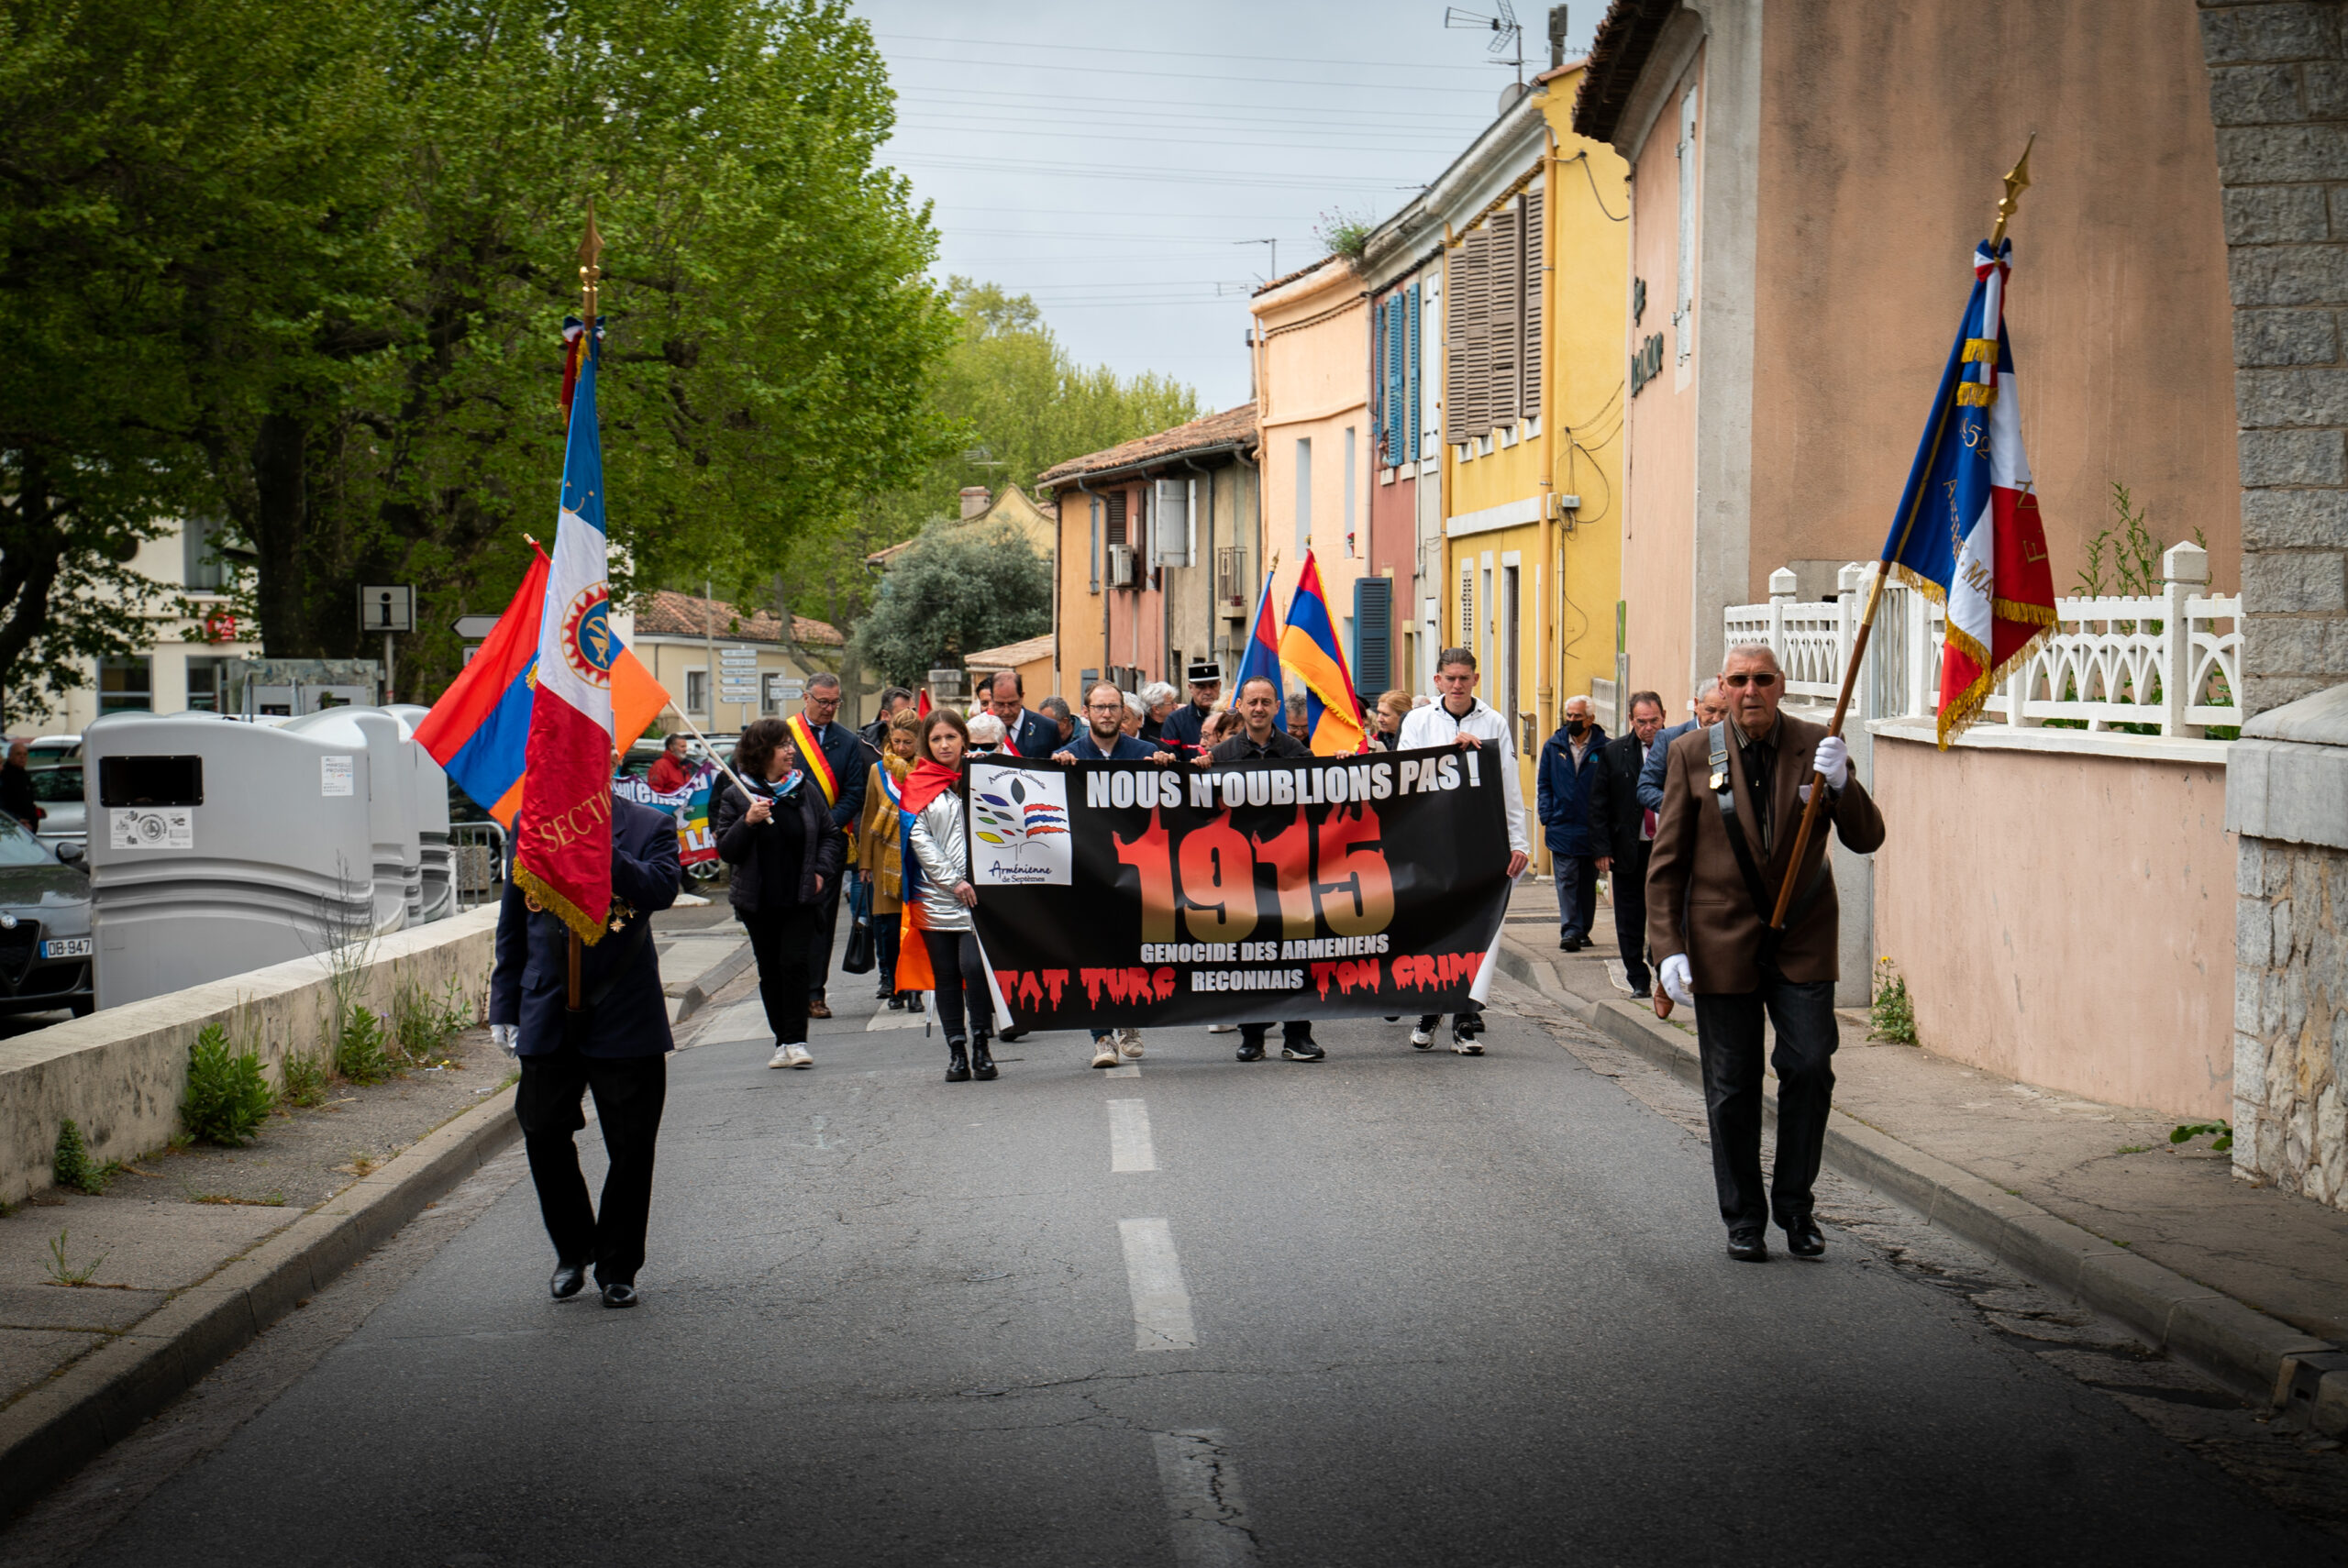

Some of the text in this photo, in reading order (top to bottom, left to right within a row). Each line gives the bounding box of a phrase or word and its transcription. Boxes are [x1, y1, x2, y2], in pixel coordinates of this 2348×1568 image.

[1086, 769, 1182, 809] NOUS
[1189, 761, 1393, 809] N'OUBLIONS
[1399, 754, 1461, 796] PAS
[988, 859, 1053, 879] Arménienne
[1001, 874, 1046, 885] de Septèmes
[1112, 803, 1395, 945] 1915
[1140, 933, 1390, 964] GENOCIDE DES ARMENIENS
[993, 968, 1069, 1013] TAT
[1080, 966, 1177, 1011] TURC
[1191, 968, 1305, 992] RECONNAIS
[1310, 958, 1381, 1003] TON
